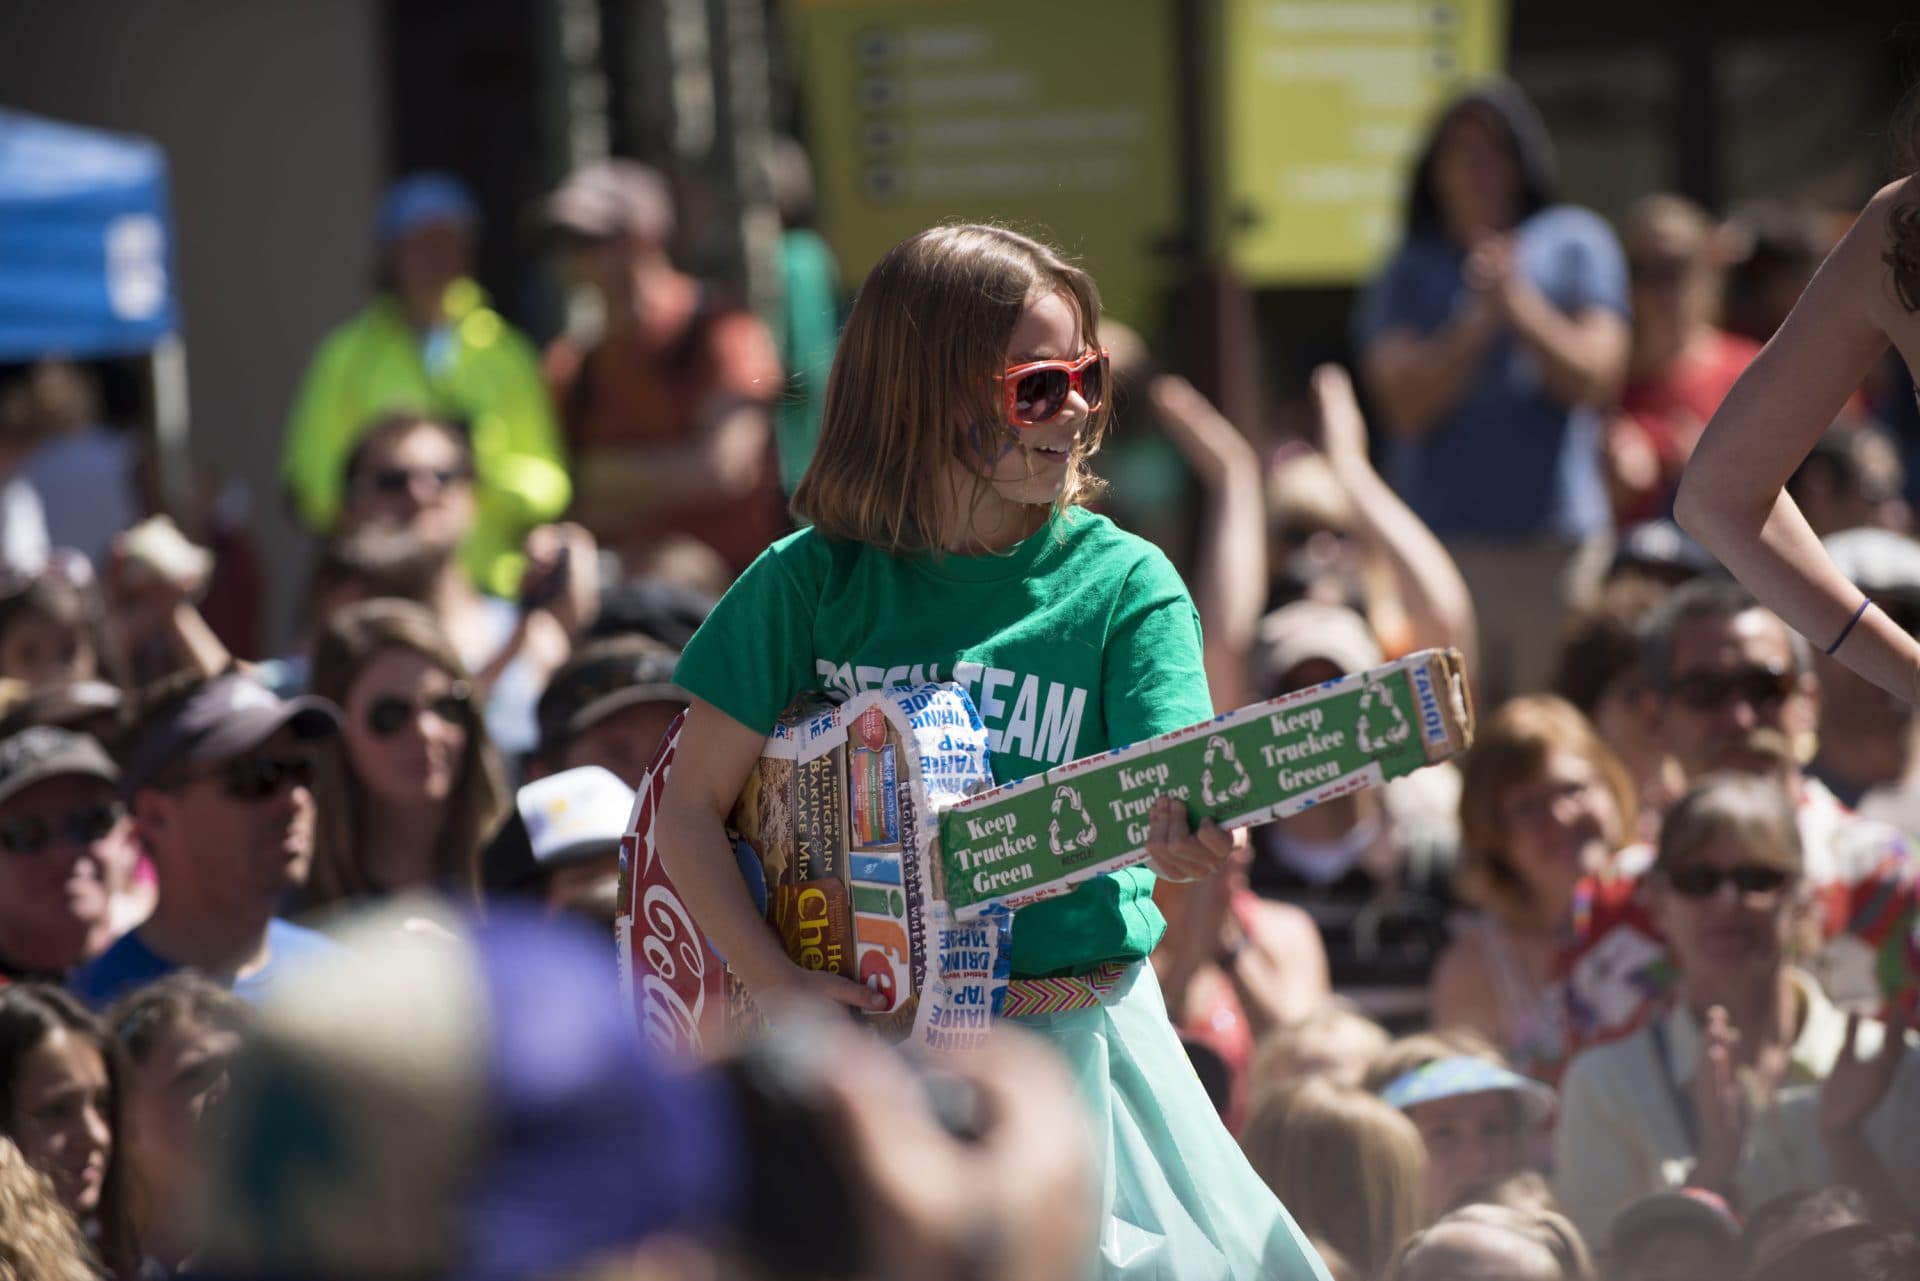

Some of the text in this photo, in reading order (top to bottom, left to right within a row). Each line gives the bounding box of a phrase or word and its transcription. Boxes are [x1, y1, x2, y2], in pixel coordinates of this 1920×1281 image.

[952, 660, 1088, 764] TEAM
[1413, 666, 1444, 738] TAHOE
[1270, 707, 1323, 737] Keep
[1260, 730, 1345, 768] Truckee
[1118, 763, 1169, 792] Keep
[1278, 761, 1341, 791] Green
[809, 760, 821, 839] BAKING
[821, 751, 833, 872] MULTIGRAIN
[797, 768, 810, 881] NCAKE MIX
[966, 812, 1017, 841] Keep
[954, 834, 1038, 871] Truckee
[973, 864, 1034, 893] Green
[911, 905, 922, 958] WHEAT
[938, 929, 990, 950] TAHOE
[939, 951, 991, 973] DRINK
[953, 986, 986, 1006] TAP
[929, 1004, 986, 1029] TAHOE
